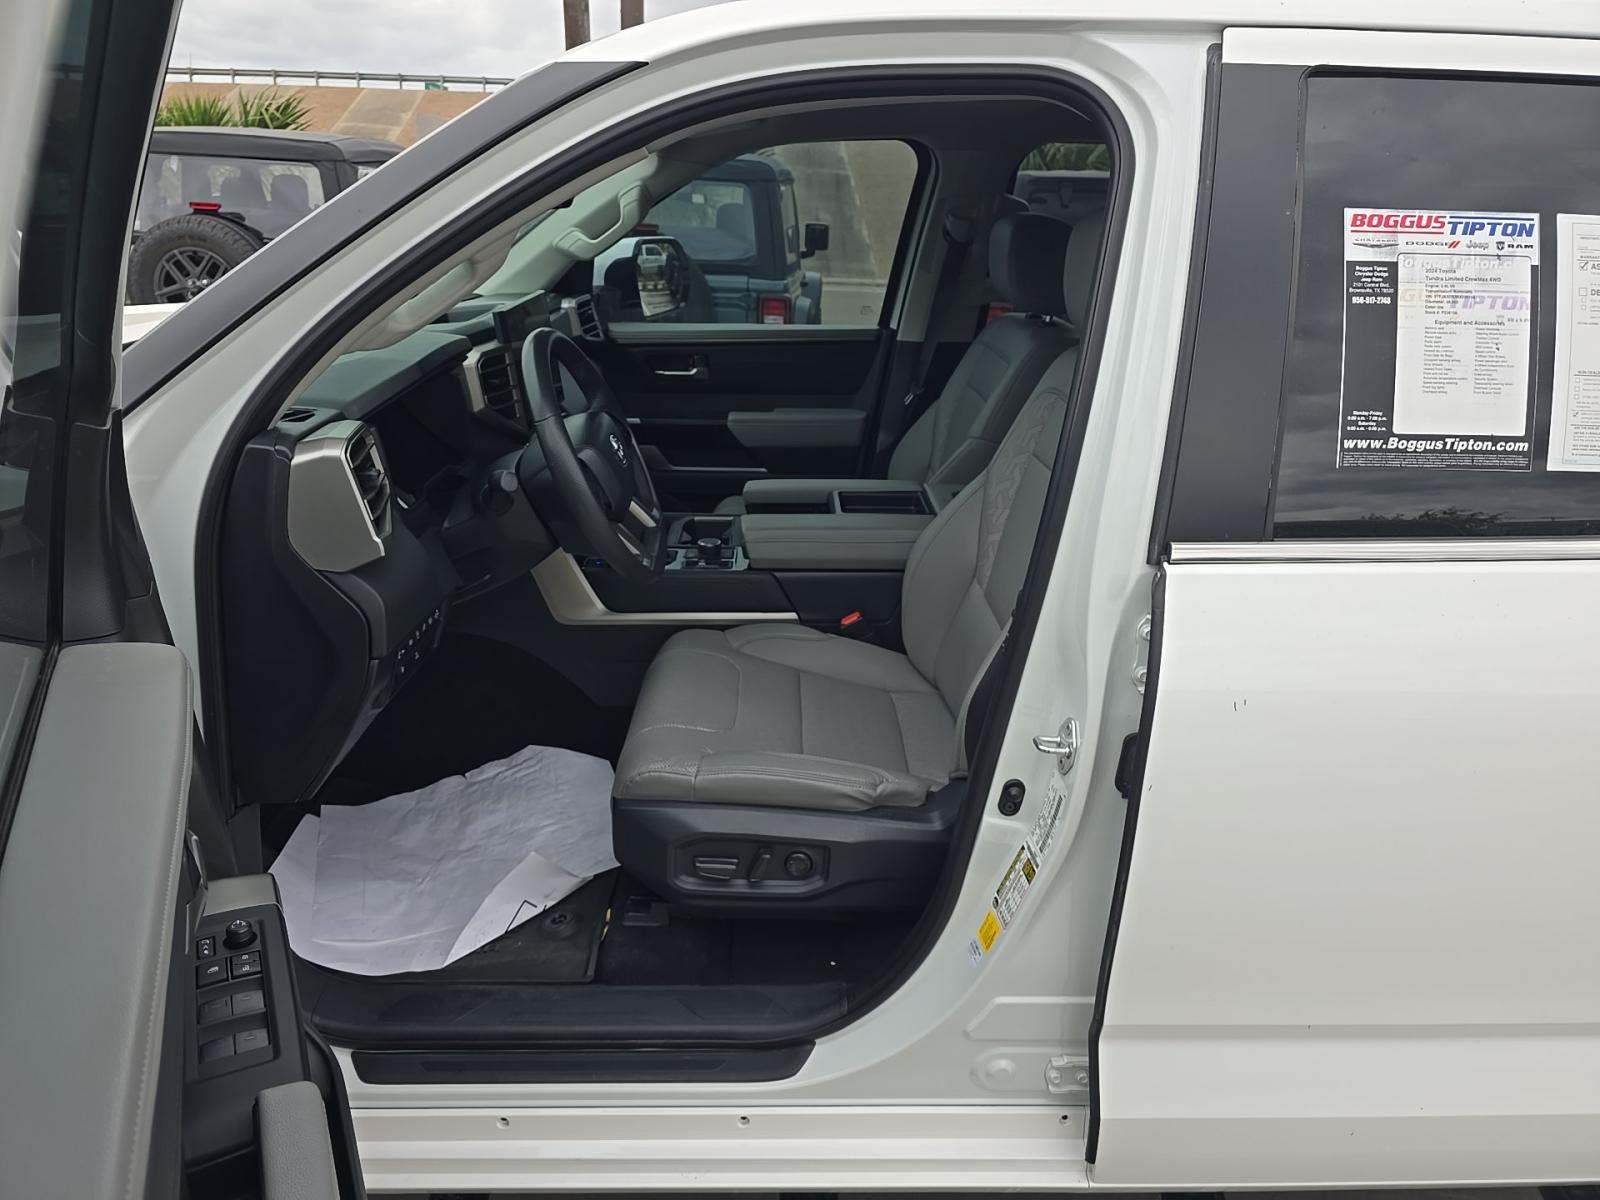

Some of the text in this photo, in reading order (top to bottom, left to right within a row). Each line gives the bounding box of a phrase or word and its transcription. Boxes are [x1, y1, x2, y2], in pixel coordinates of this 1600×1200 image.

[1350, 213, 1447, 229] BOGGUS
[1447, 221, 1536, 238] TIPTON
[1465, 240, 1490, 251] Jeep
[1434, 319, 1462, 327] Equipment
[1343, 436, 1529, 452] www.BoggusTipton.com
